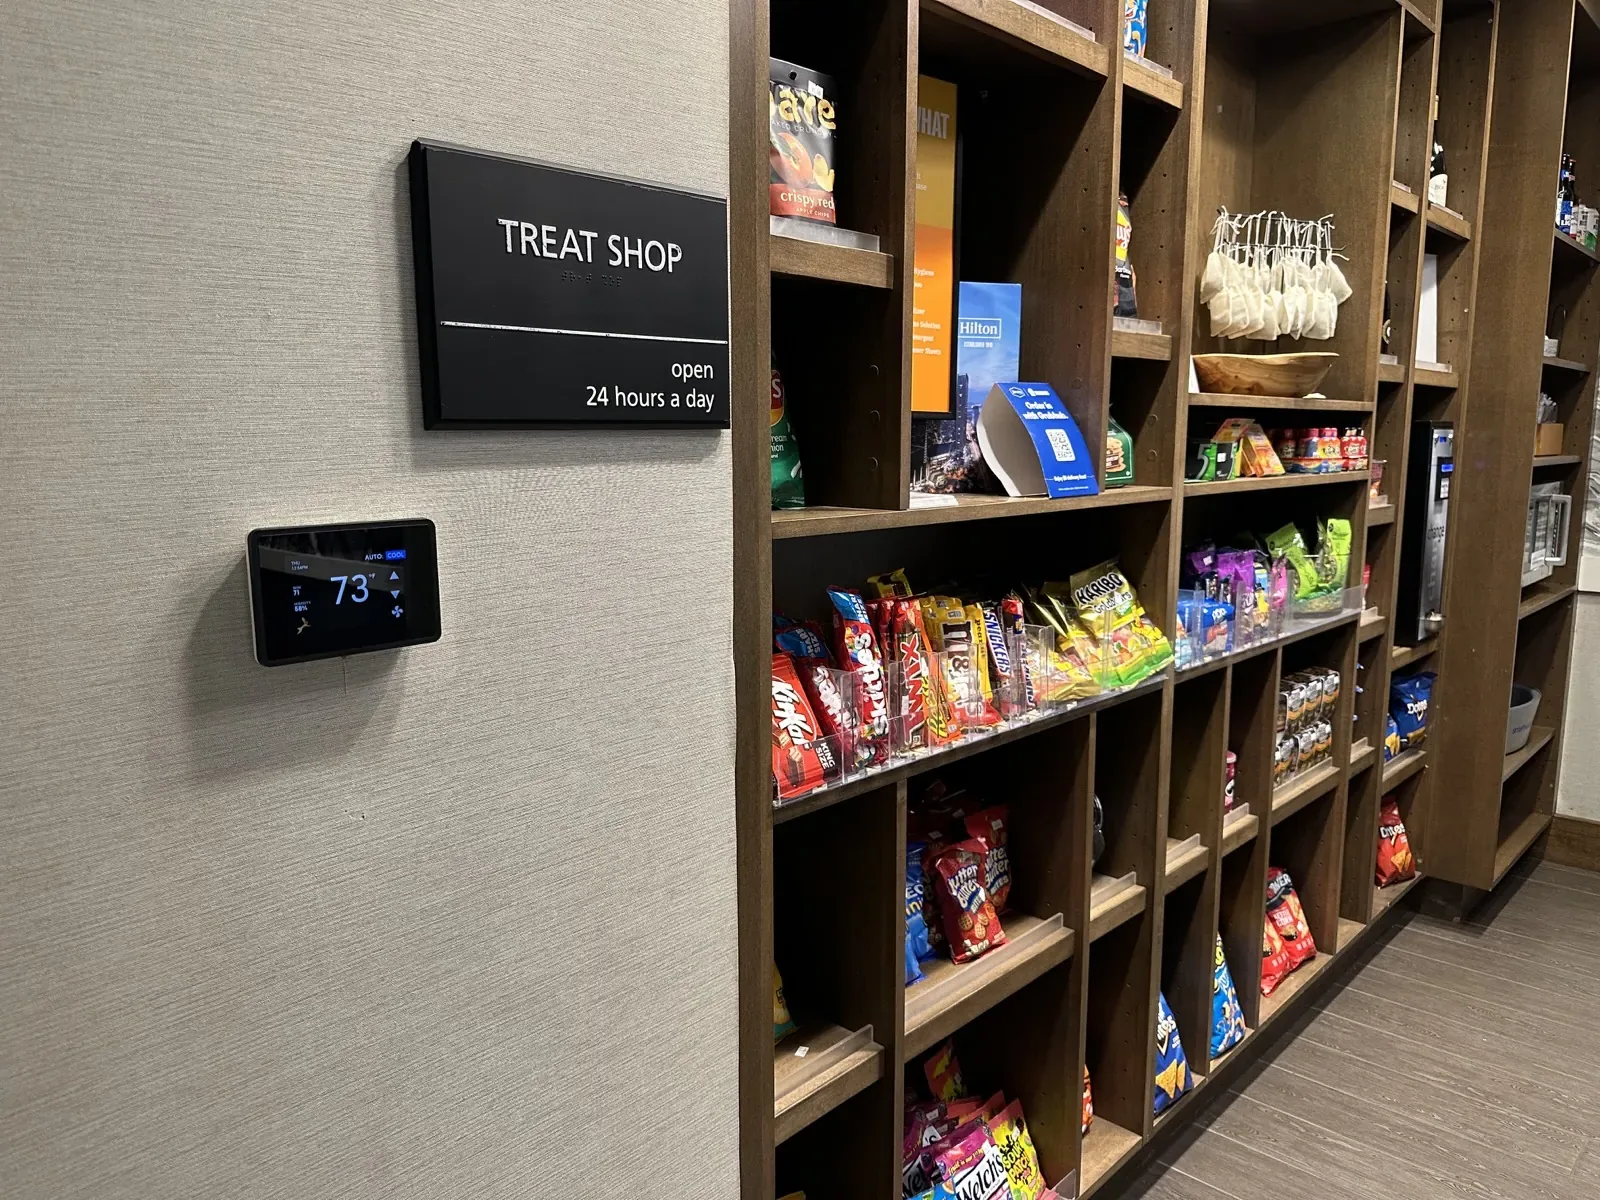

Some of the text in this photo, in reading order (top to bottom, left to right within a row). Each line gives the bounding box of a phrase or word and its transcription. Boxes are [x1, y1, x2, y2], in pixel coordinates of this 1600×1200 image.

[780, 191, 815, 209] crispy
[497, 218, 683, 274] TREAT SHOP
[960, 321, 997, 335] Hilton
[671, 361, 715, 383] open
[586, 385, 715, 413] 24 hours a day
[365, 551, 405, 560] AUTO: COOL
[330, 574, 369, 605] 73
[1075, 572, 1123, 605] HARIBO
[983, 609, 1012, 675] SNICKERS
[854, 632, 889, 736] Skittles
[900, 632, 926, 747] TWIX
[815, 747, 830, 770] SIZE
[820, 741, 836, 768] KING
[1002, 1141, 1025, 1169] SOUR
[955, 1152, 1006, 1200] Welch's
